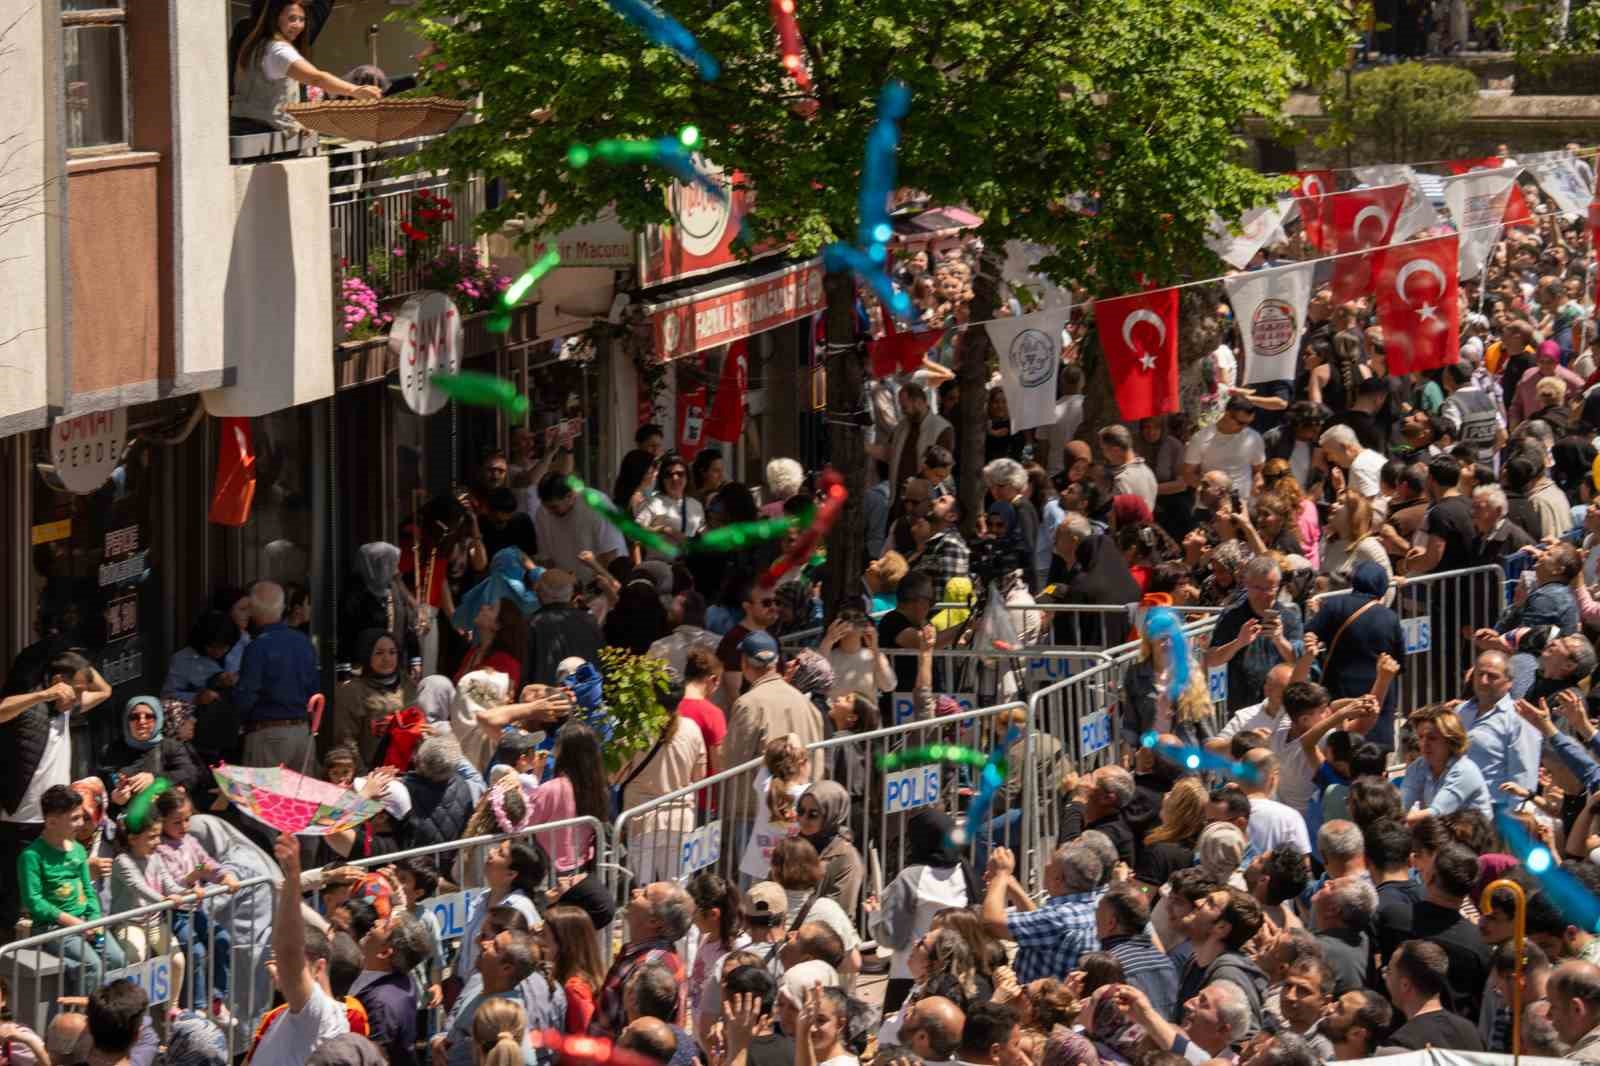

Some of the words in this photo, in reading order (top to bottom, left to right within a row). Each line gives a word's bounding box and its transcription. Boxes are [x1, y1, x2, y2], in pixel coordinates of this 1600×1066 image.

[1402, 620, 1429, 651] LİS
[887, 768, 938, 810] POLİS
[433, 892, 470, 937] OLİ
